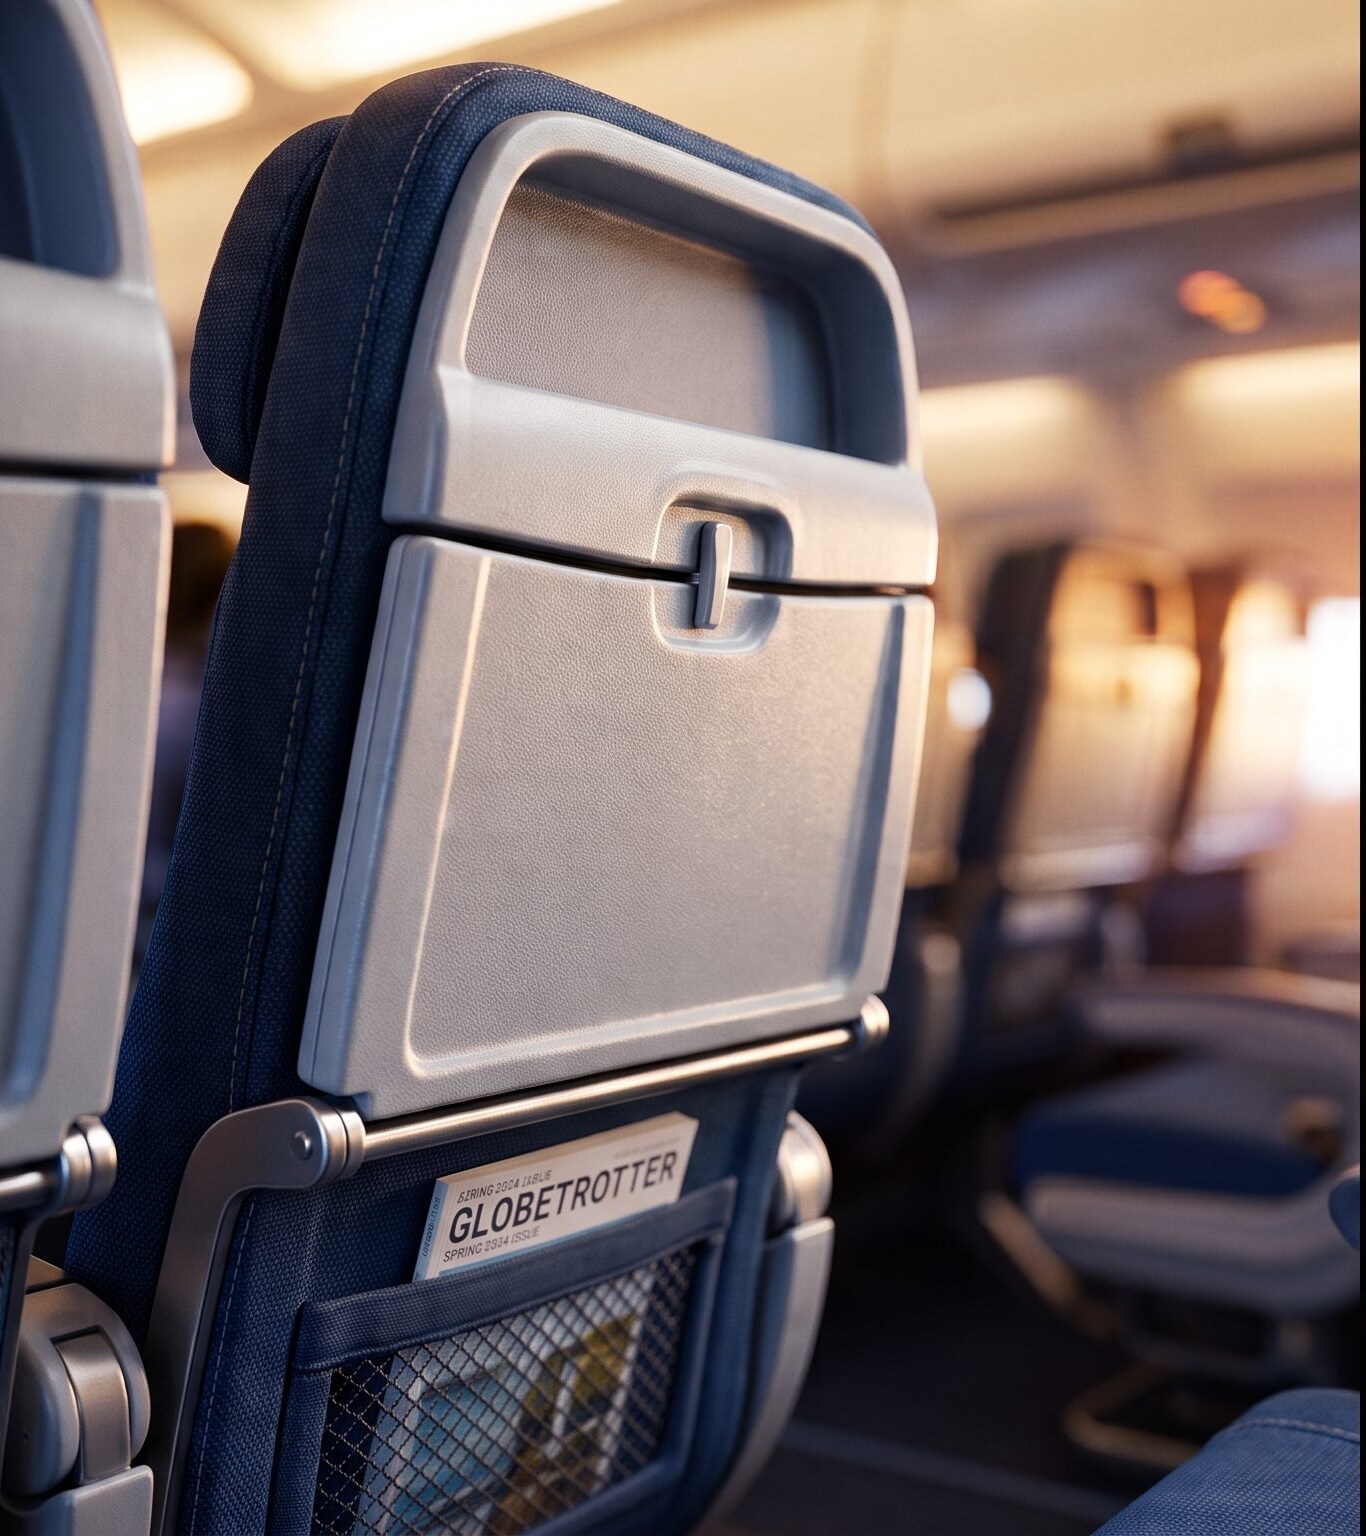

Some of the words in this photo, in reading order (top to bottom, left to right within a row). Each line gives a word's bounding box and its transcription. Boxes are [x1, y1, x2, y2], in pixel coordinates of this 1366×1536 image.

[449, 1150, 677, 1244] GLOBETROTTER
[443, 1242, 483, 1262] SPRING
[510, 1226, 540, 1244] ISSUE
